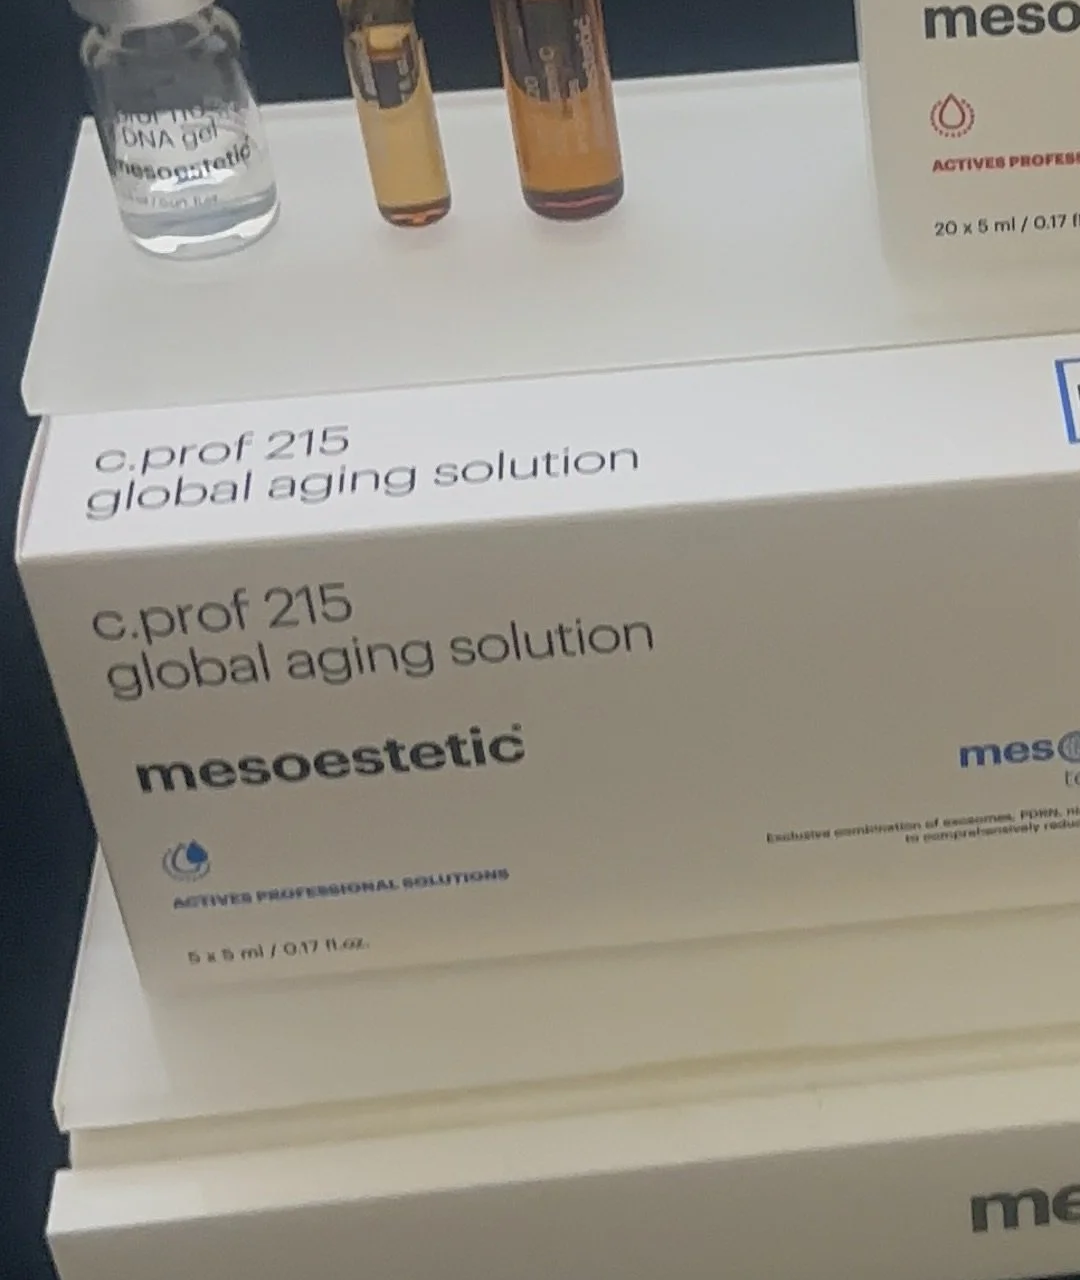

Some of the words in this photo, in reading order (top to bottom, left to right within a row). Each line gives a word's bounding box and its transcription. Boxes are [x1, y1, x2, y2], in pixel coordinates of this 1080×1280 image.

[122, 126, 175, 150] DNA
[182, 118, 217, 151] gel
[932, 157, 1006, 173] ACTIVES
[935, 220, 957, 237] 20
[963, 223, 973, 235] x
[977, 218, 989, 234] 5
[994, 216, 1016, 233] ml
[1020, 215, 1029, 233] /
[1033, 214, 1067, 231] 0.17
[94, 433, 253, 477] c.prof
[265, 425, 351, 461] 215
[85, 469, 252, 521] global
[267, 461, 418, 504] aging
[432, 445, 641, 484] solution
[92, 588, 250, 645] c.prof
[263, 582, 354, 630] 215
[106, 641, 272, 702] global
[286, 631, 434, 685] aging
[449, 617, 655, 666] solution
[925, 817, 939, 829] of
[172, 891, 252, 910] ACTIVES
[256, 879, 398, 903] PROFESSIONAL
[402, 868, 510, 889] SOLUTIONS
[187, 950, 200, 964] 5
[206, 951, 216, 963] x
[221, 948, 234, 961] 5
[240, 943, 264, 959] ml
[270, 942, 277, 958] /
